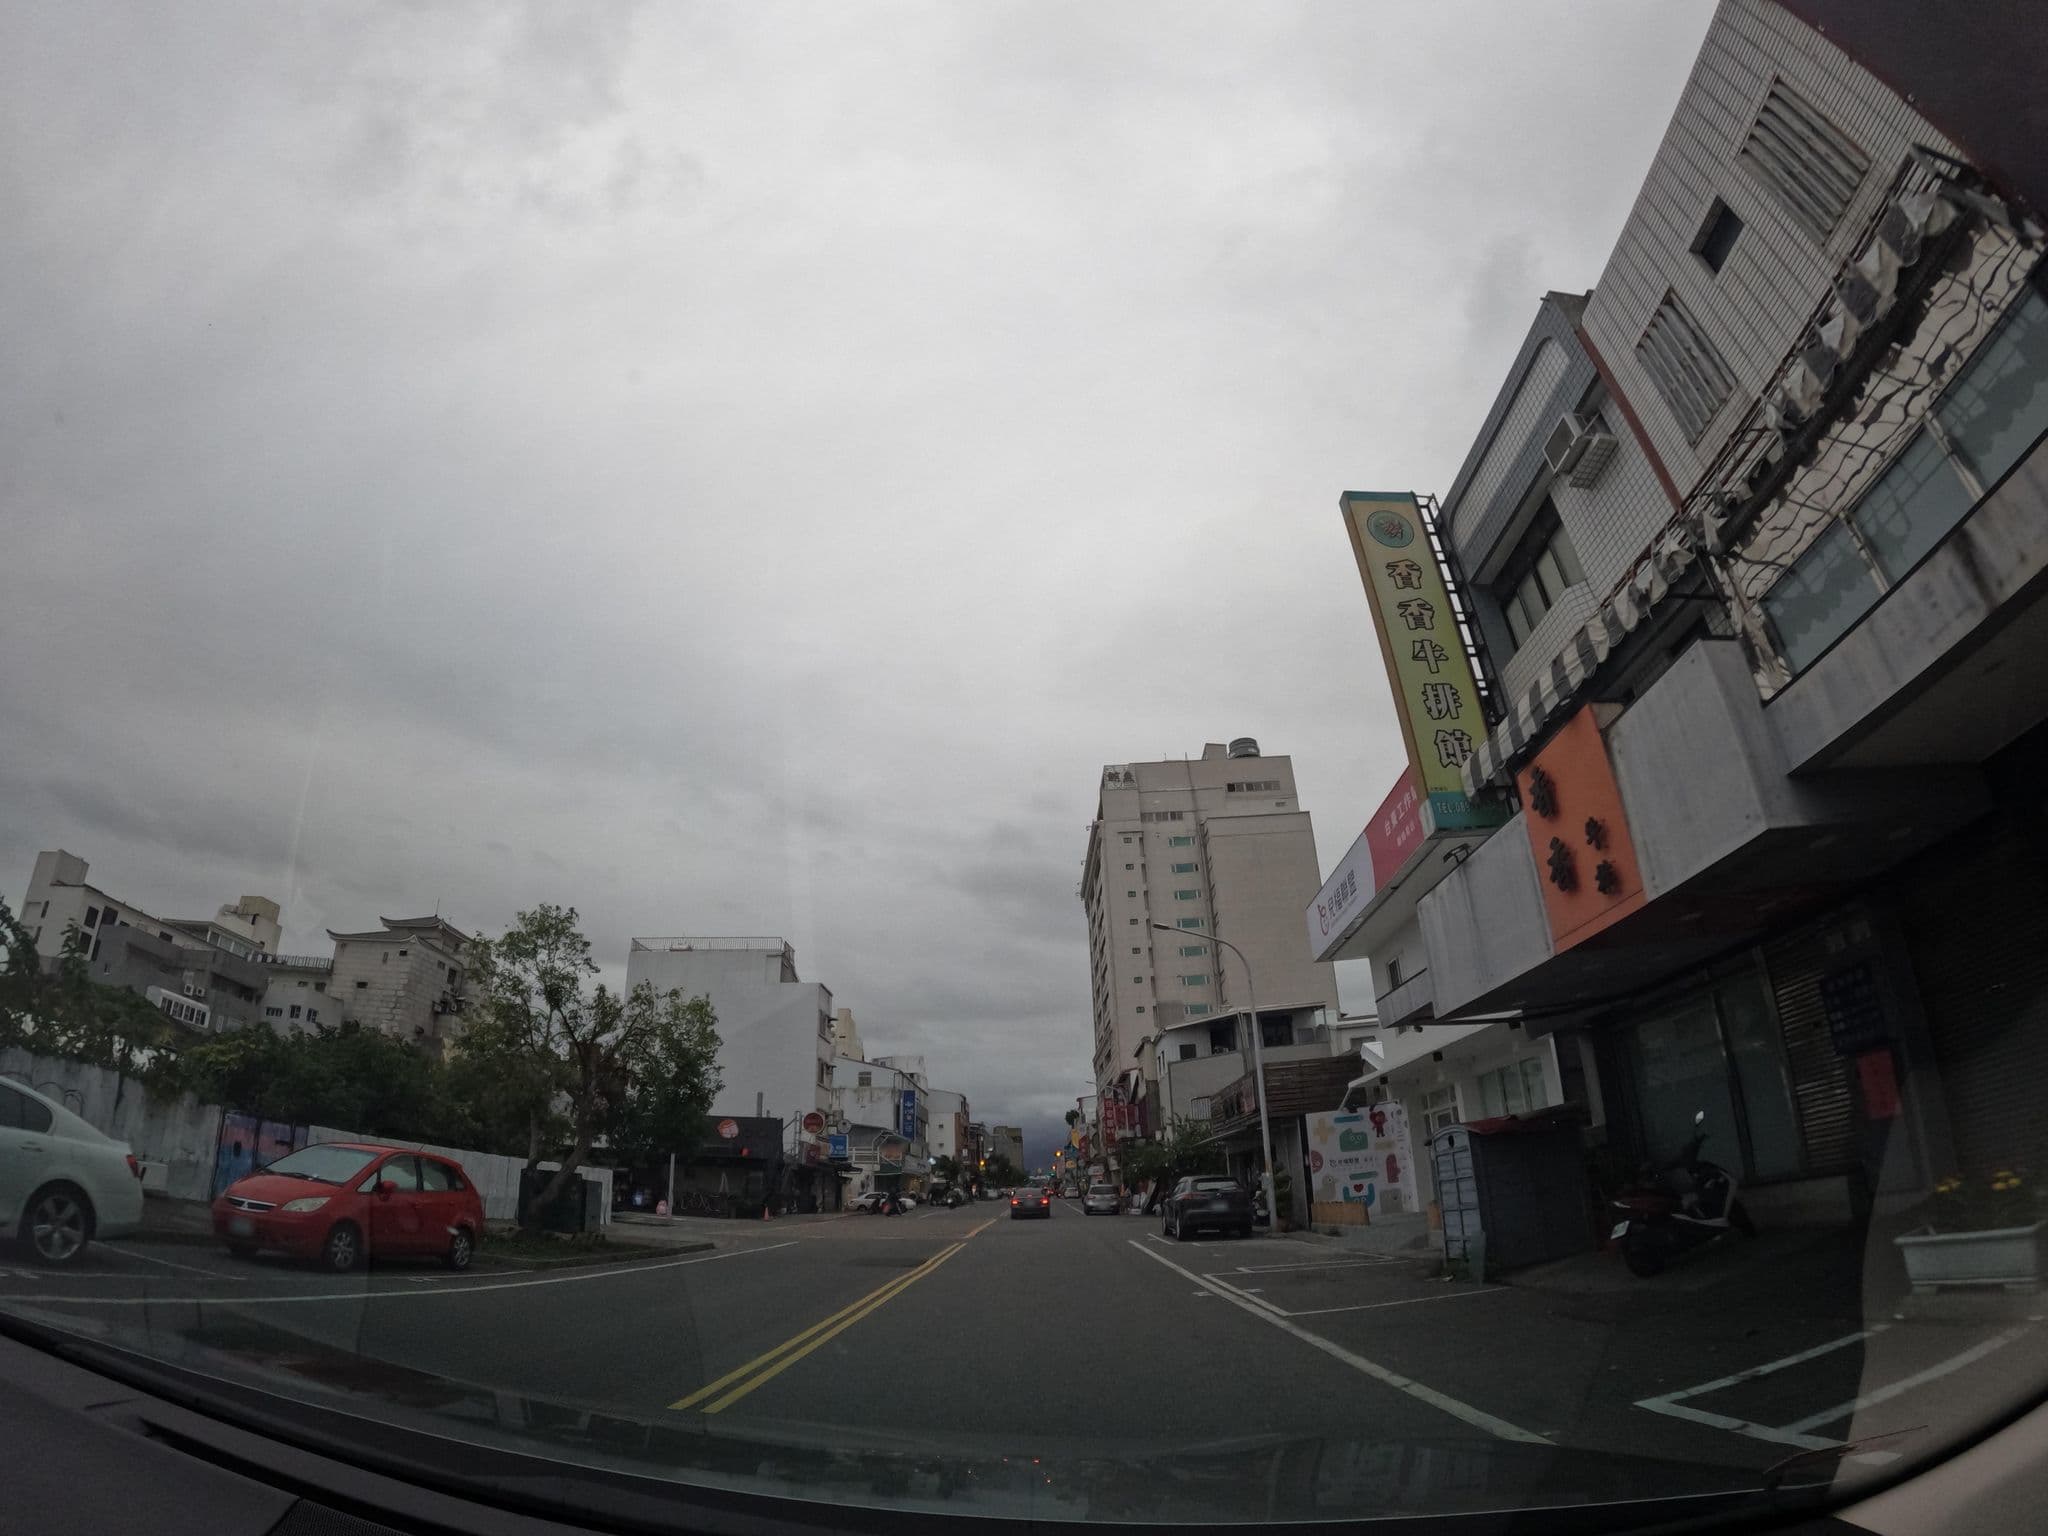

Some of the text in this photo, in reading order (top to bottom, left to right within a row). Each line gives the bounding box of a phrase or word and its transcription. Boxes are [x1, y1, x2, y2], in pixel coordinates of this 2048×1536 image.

[1385, 558, 1472, 768] 香香牛排館
